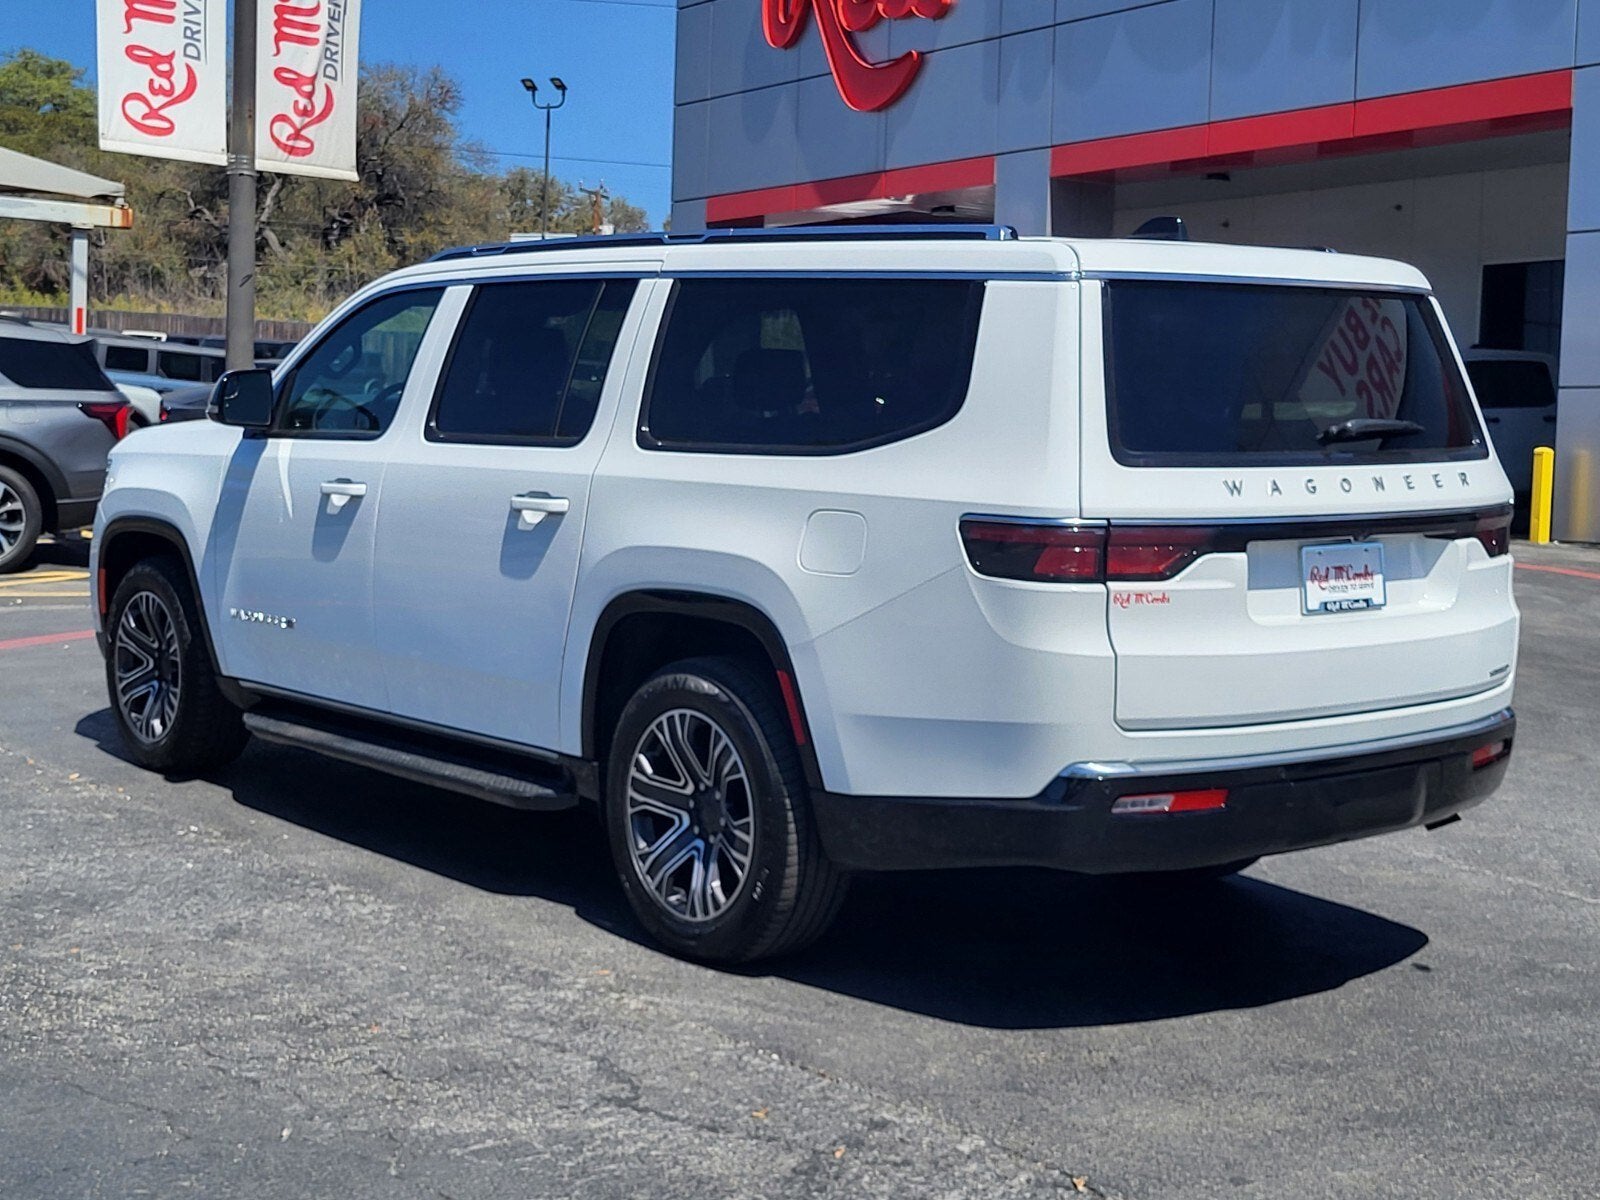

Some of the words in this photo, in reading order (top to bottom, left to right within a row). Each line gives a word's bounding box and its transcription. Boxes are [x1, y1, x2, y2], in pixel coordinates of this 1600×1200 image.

[183, 0, 202, 62] DRIV
[272, 0, 321, 57] M
[121, 45, 198, 137] Red
[269, 66, 335, 157] Red
[1222, 471, 1470, 497] WAGONEER
[1310, 565, 1329, 590] Red
